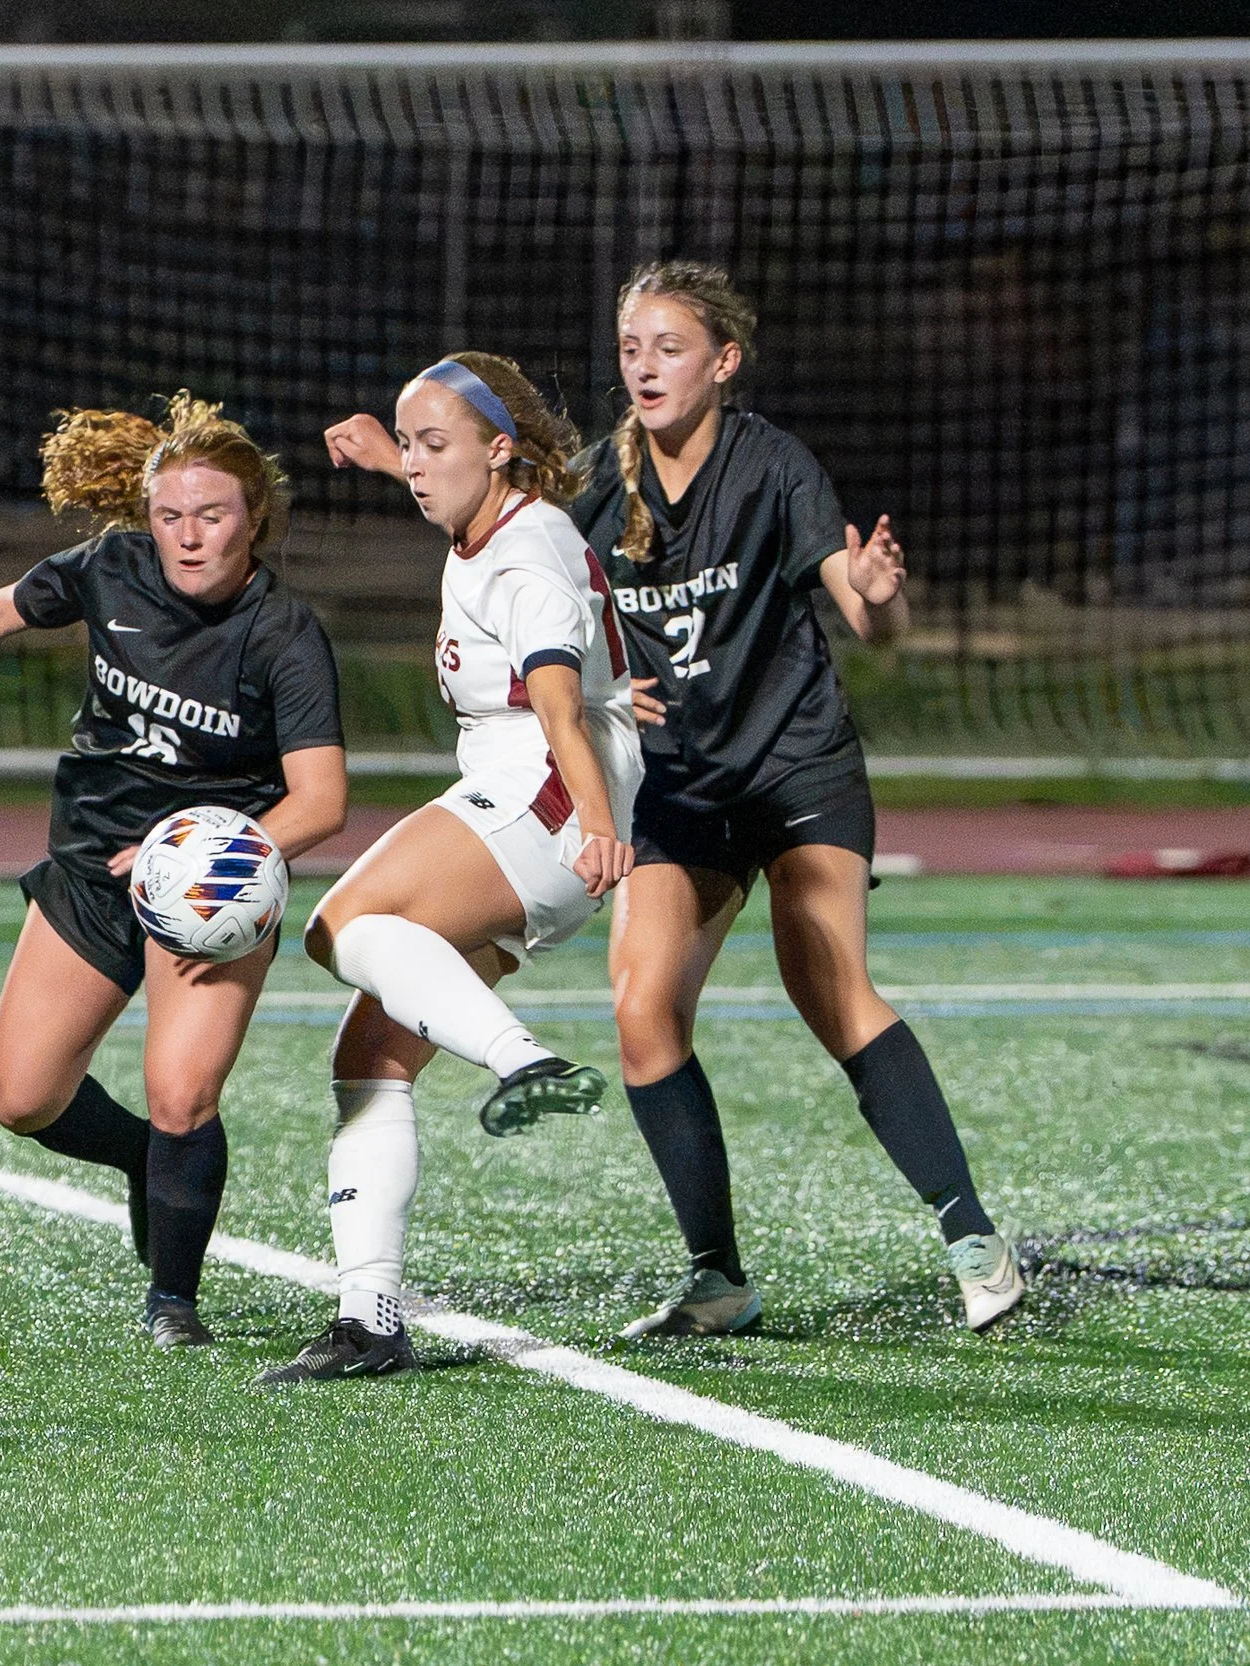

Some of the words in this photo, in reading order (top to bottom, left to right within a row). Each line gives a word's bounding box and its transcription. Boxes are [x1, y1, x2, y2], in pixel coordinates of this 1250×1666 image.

[613, 562, 739, 614] BOWDIN
[663, 606, 711, 680] 2
[94, 654, 241, 738] BOWDOIN
